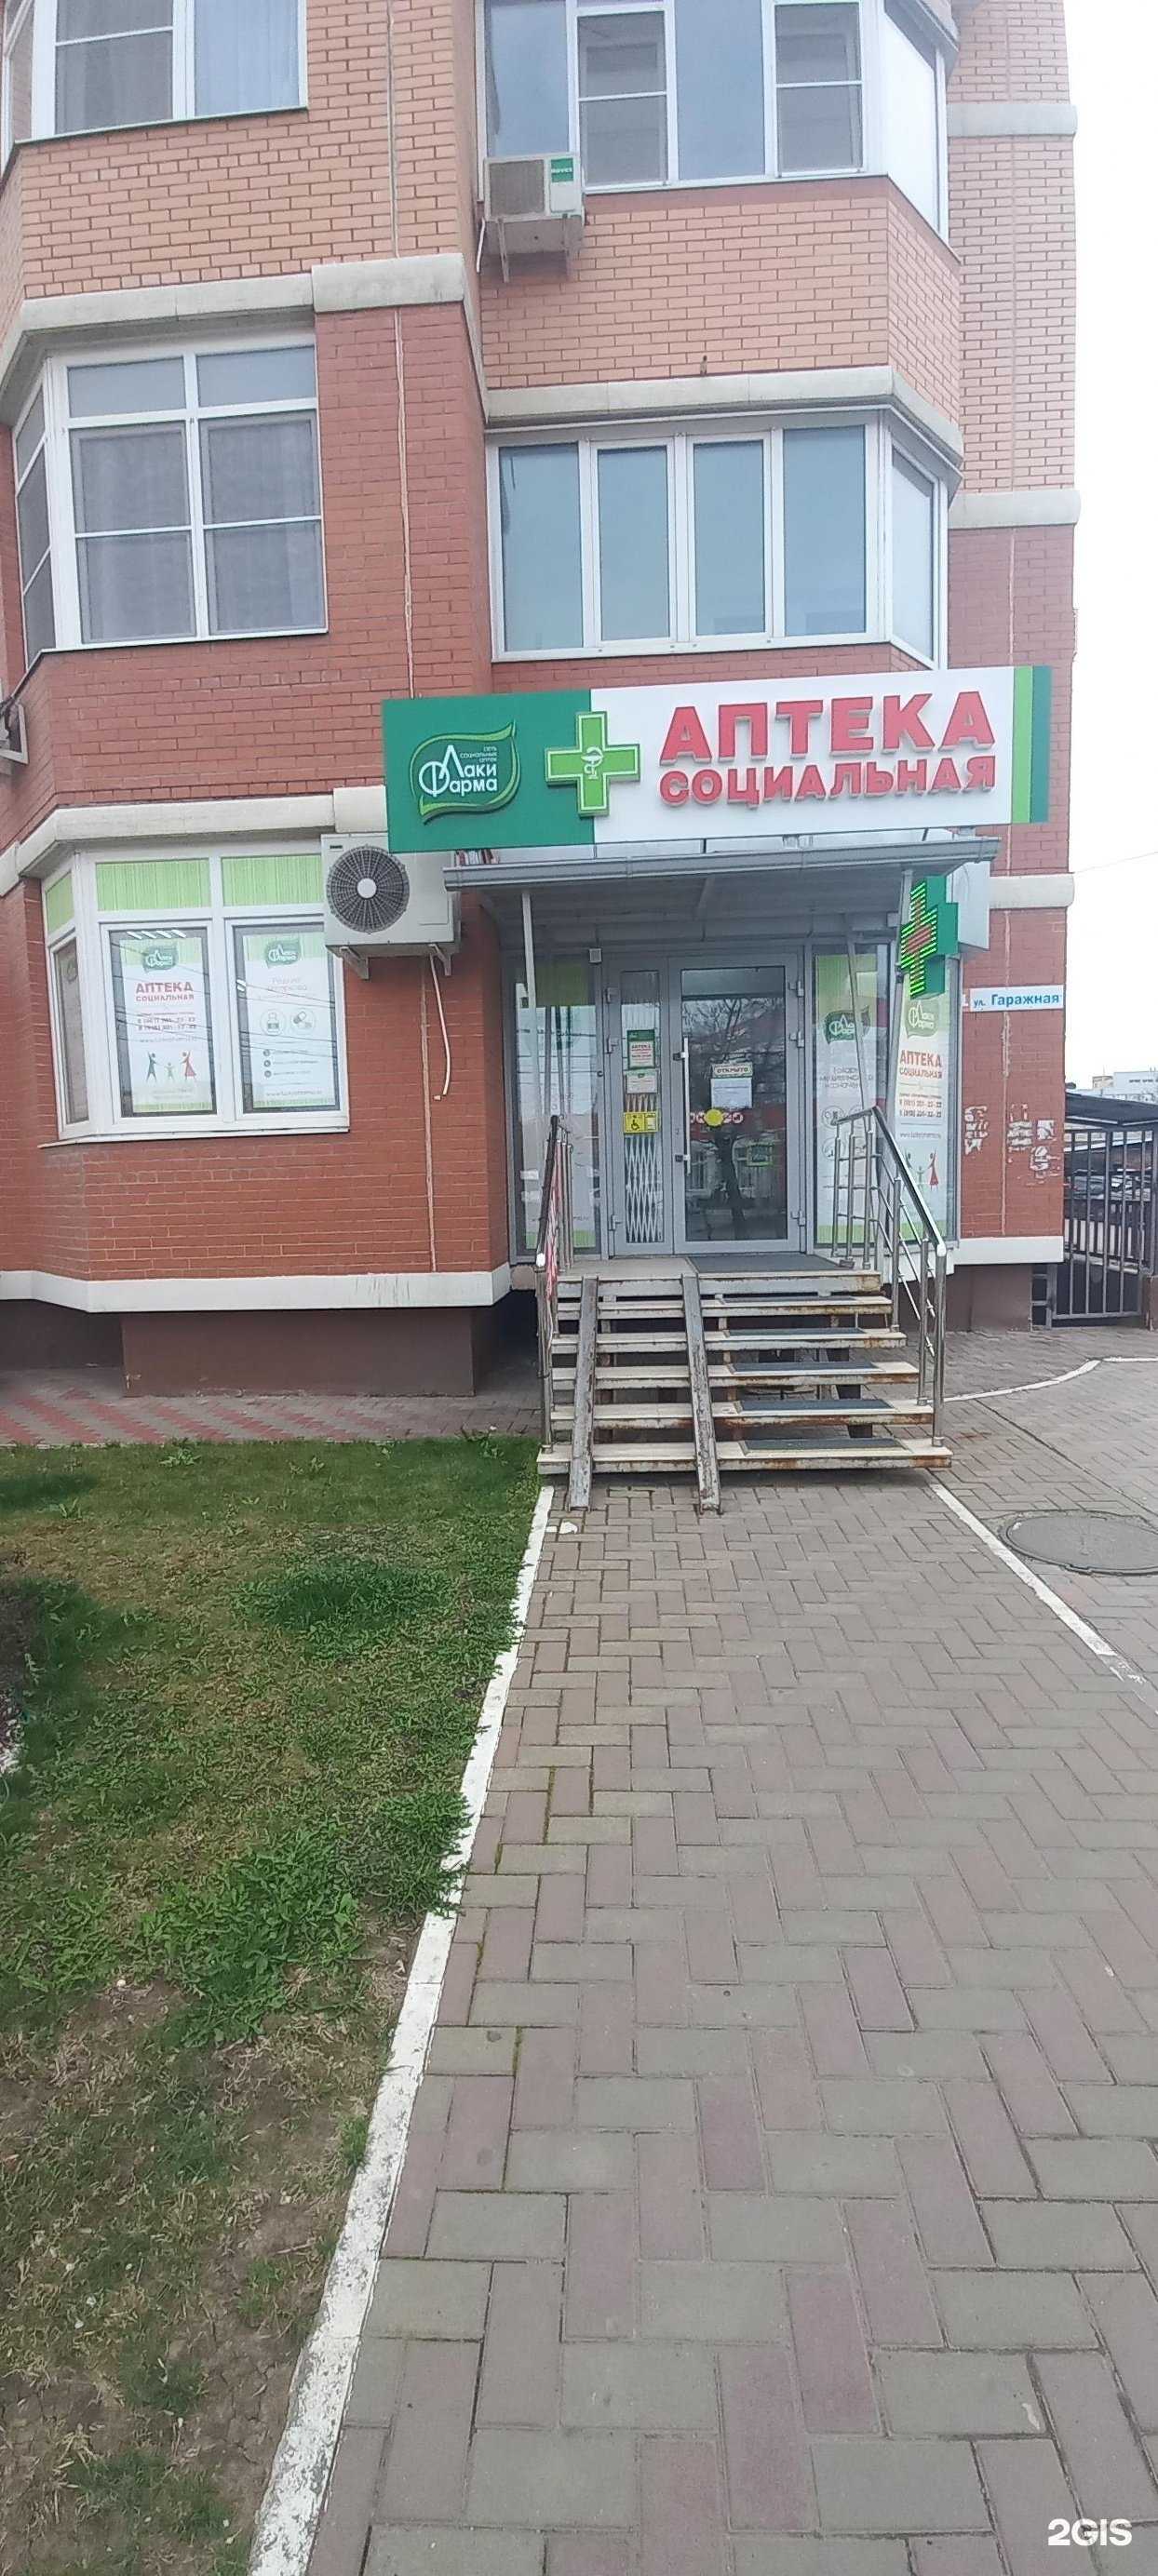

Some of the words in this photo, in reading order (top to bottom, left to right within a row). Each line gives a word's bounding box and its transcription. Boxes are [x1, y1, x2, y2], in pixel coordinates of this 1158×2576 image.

[659, 691, 995, 765] АПТЕКА
[438, 745, 497, 779] Лаки
[418, 760, 498, 798] Фарма
[659, 755, 995, 808] СОЦИАЛЬНАЯ
[135, 994, 195, 1002] СОЦИАЛЬНАЯ
[136, 981, 194, 994] АПТЕКА
[974, 999, 986, 1008] ул.
[991, 994, 1059, 1007] Гаражная
[900, 1050, 942, 1067] АПТЕКА
